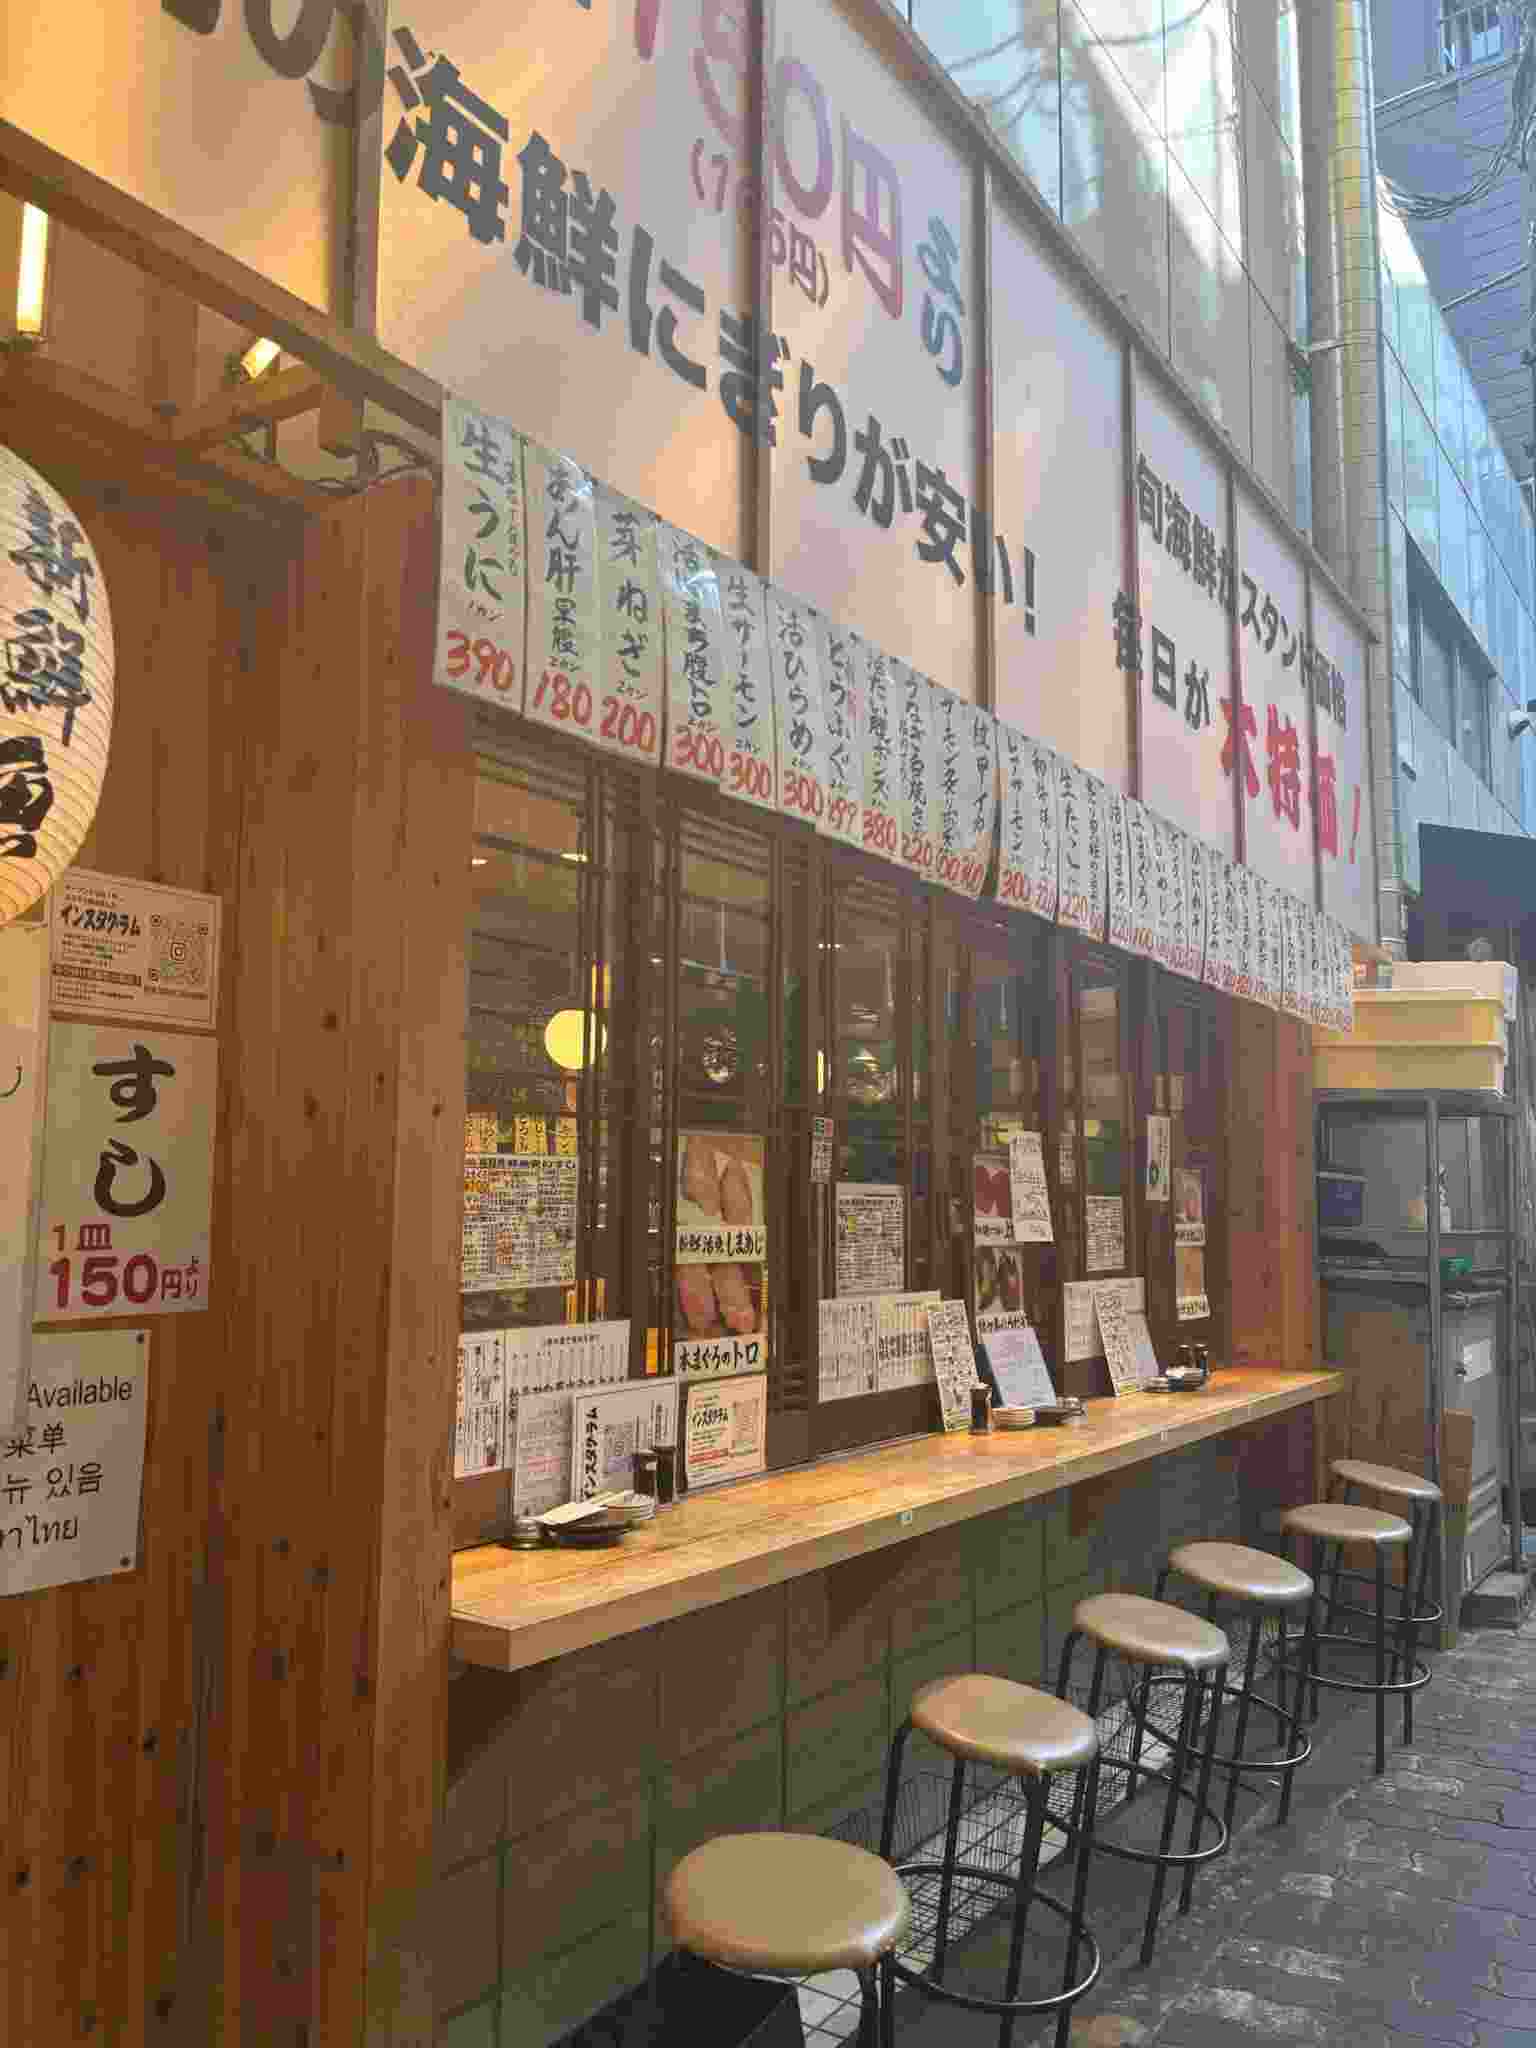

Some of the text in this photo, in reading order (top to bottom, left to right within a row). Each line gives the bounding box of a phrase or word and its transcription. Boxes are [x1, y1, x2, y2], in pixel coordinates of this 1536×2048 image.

[461, 415, 504, 602] 生うに
[610, 511, 648, 677] 芽ねぎ
[447, 629, 513, 690] 390
[728, 576, 761, 729] 生サーモン
[534, 670, 592, 723] 180
[775, 600, 823, 817] 活ひらめ 300
[602, 696, 656, 752] 200
[672, 732, 724, 777] 300
[726, 751, 771, 801] 300
[863, 809, 896, 849] 380
[60, 904, 142, 938] インスタグラム
[92, 1043, 176, 1218] すし
[51, 1222, 113, 1251] 1皿
[28, 1375, 133, 1408] Available
[46, 1462, 104, 1500] 있음
[0, 1515, 80, 1549] าไทย
